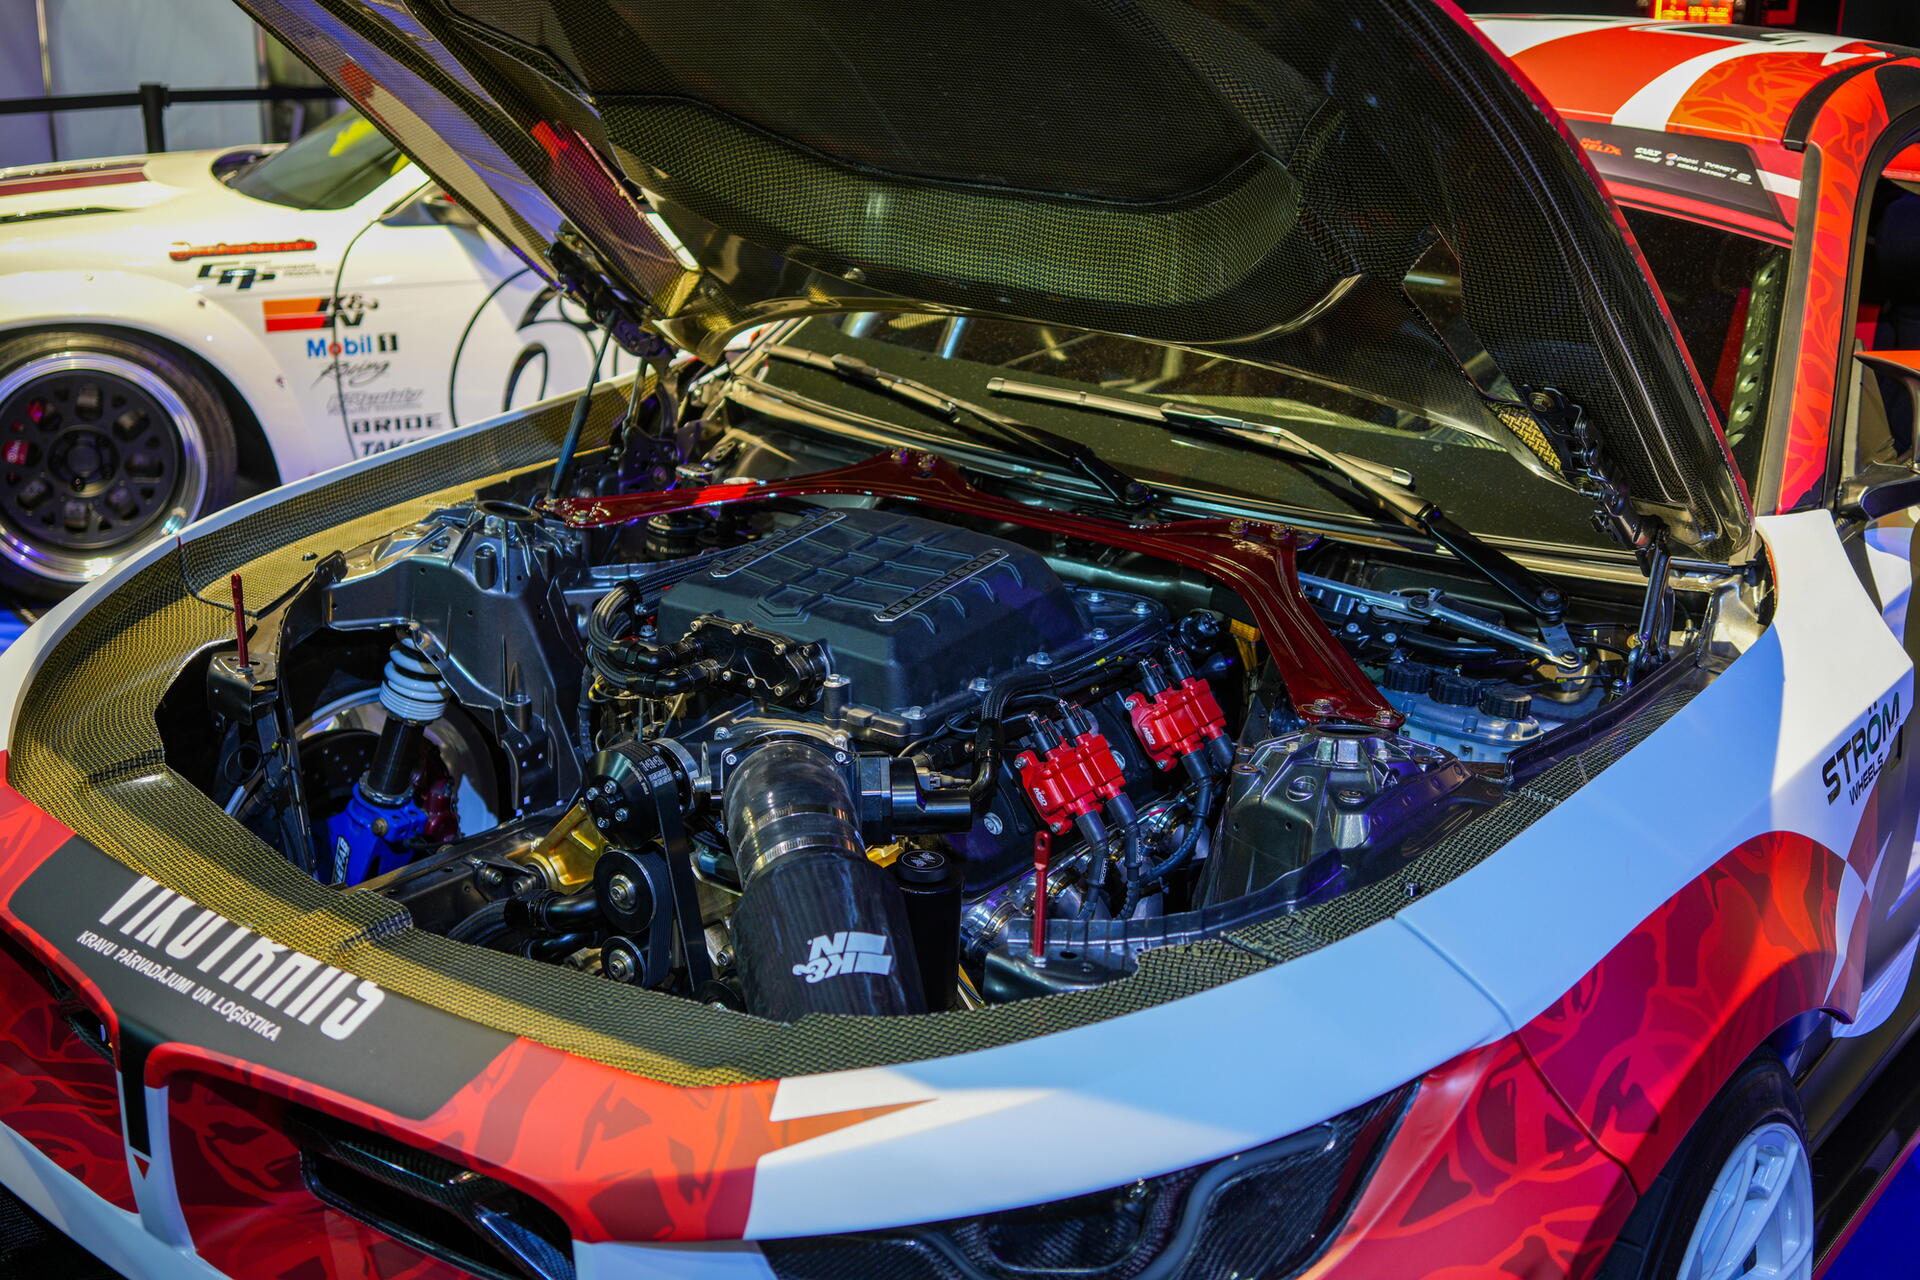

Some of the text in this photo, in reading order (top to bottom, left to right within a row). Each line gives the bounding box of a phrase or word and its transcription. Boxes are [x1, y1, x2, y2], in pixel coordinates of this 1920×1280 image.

[306, 335, 373, 357] Mobil
[351, 413, 443, 434] BRIDE
[885, 551, 999, 617] MAGNUSON
[1821, 691, 1900, 806] STRÖM
[1849, 751, 1884, 806] WHEELS
[76, 929, 282, 1043] KRAVU PĀRVADĀJUMI UN LOĢISTIKA
